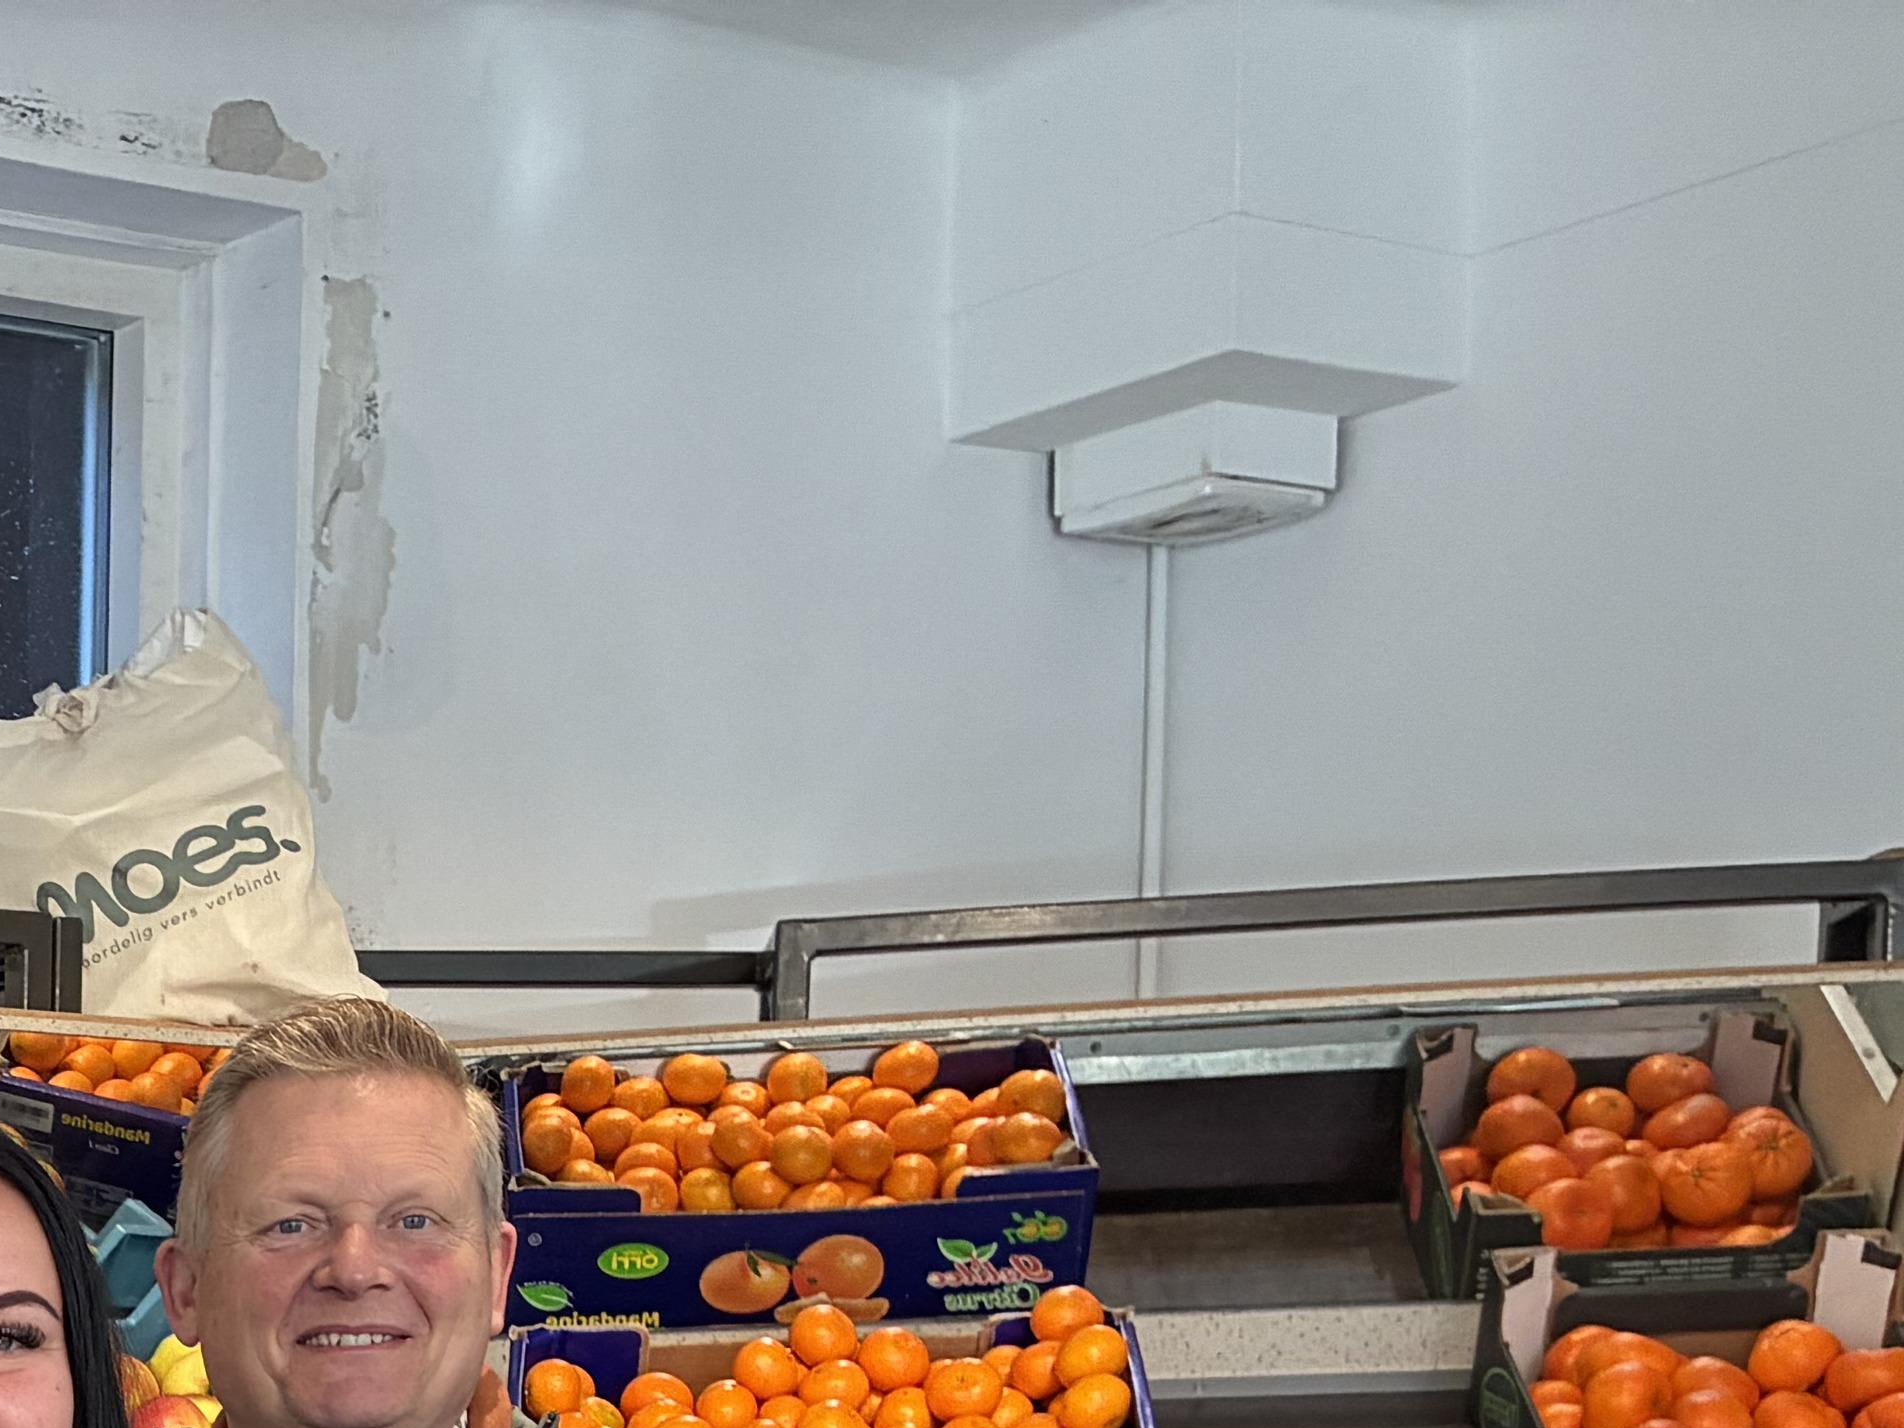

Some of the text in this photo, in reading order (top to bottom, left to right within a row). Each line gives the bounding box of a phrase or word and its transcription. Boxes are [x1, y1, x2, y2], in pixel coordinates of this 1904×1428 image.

[81, 869, 282, 969] oordelig vers verbindt
